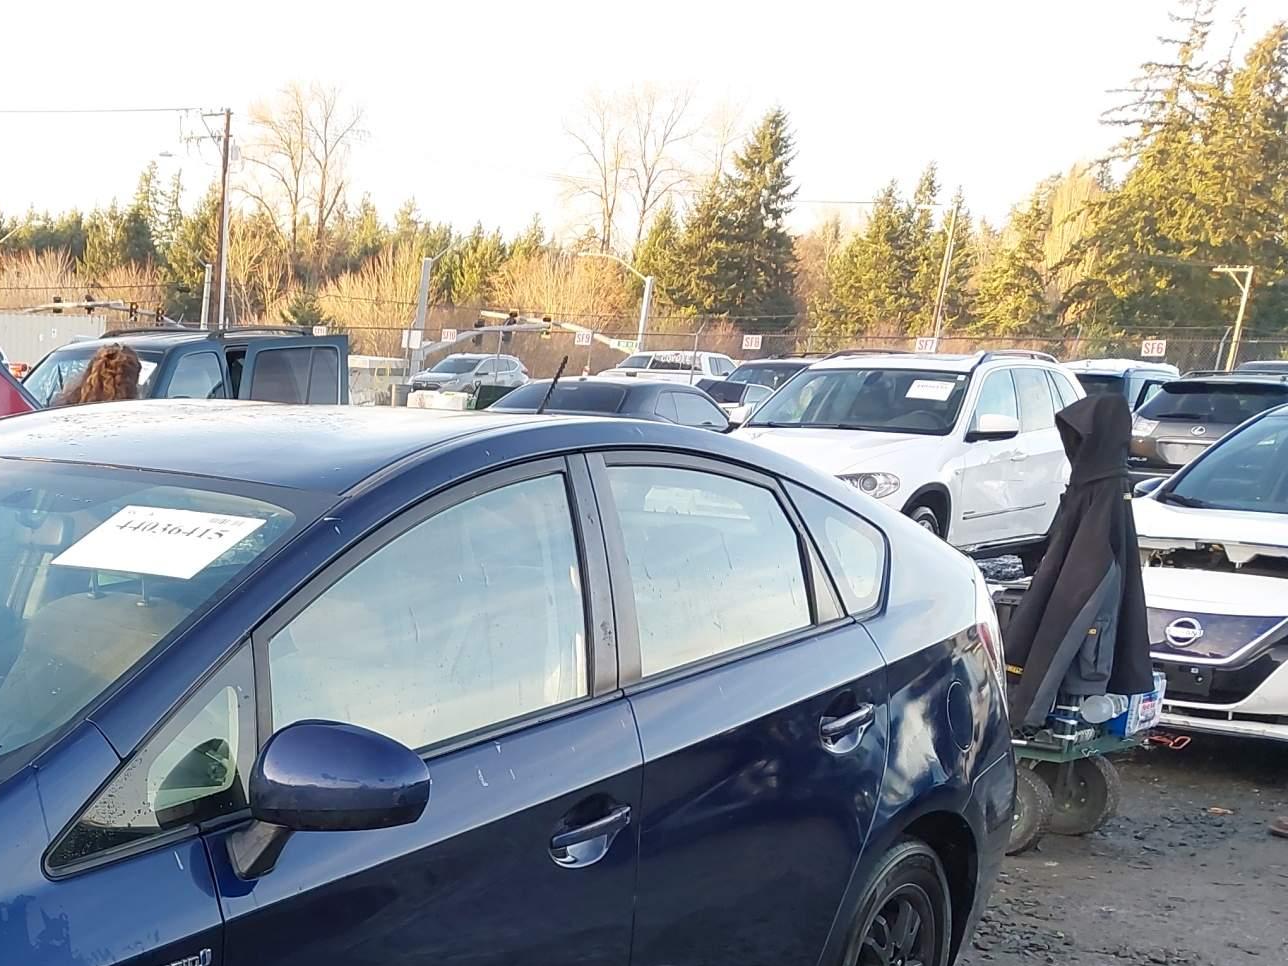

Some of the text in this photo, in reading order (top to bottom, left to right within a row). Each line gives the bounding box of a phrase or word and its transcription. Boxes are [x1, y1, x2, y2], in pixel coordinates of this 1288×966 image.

[576, 332, 591, 344] SF9
[918, 339, 935, 351] SF7
[1143, 342, 1164, 355] SF6
[115, 518, 230, 540] 44036415
